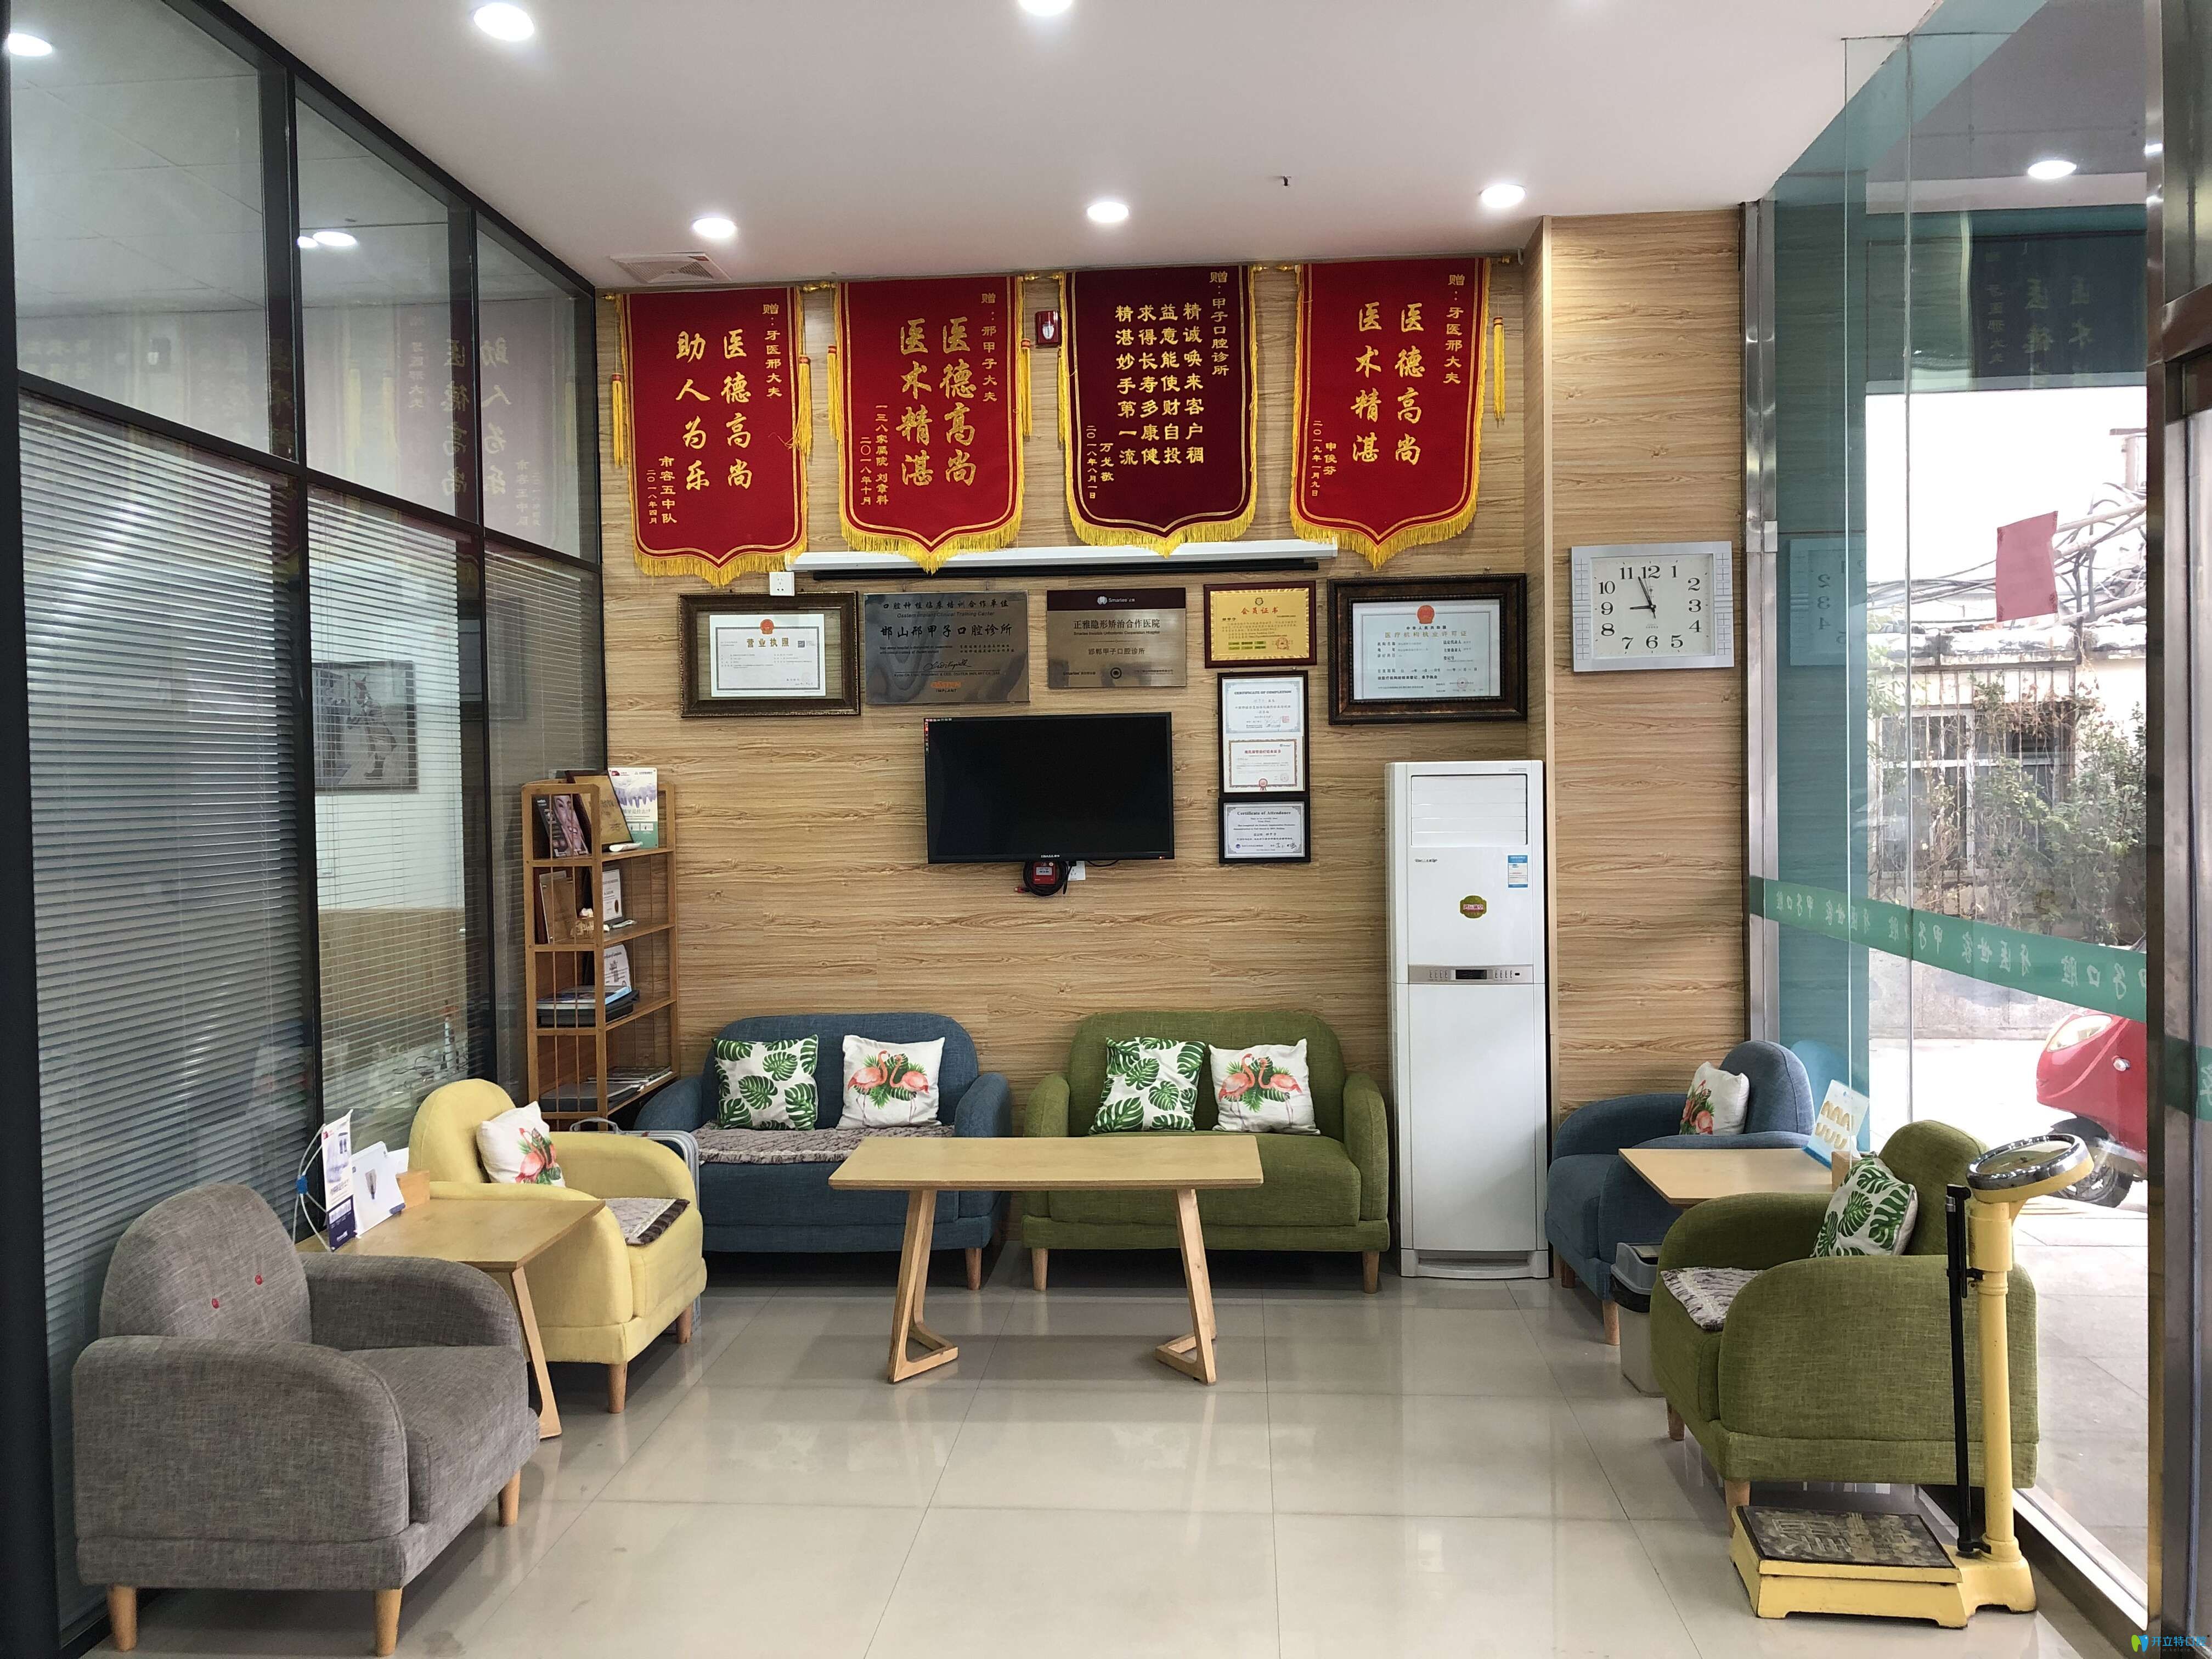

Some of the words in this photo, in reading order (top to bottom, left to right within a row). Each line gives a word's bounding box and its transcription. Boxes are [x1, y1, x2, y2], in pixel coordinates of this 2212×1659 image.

[1115, 304, 1138, 466] 精湛妙手第一流
[1137, 304, 1160, 465] 求得长寿多康健
[1159, 304, 1182, 465] 益意能使财自投
[1183, 302, 1205, 464] 精诚唤来客户稠
[1350, 301, 1383, 462] 医术精湛
[1395, 302, 1426, 466] 医德高尚
[895, 318, 933, 486] 医术精湛
[939, 316, 977, 486] 医德高尚
[675, 331, 710, 491] 助人为乐
[720, 329, 753, 490] 医德高尚
[659, 456, 677, 524] 市容五中队
[1620, 567, 1633, 579] 11
[1641, 565, 1661, 579] 12
[1671, 565, 1677, 578] 1
[1599, 580, 1616, 594] 10
[1688, 578, 1700, 591] 2
[1241, 606, 1278, 614] 会员证书
[1601, 602, 1613, 615] 9
[1689, 599, 1701, 612] 3
[1073, 619, 1160, 629] 正雅隐形矫治合作医院
[1601, 623, 1615, 636] 8
[1689, 620, 1702, 633] 4
[880, 623, 1013, 640] 邯山邢甲子口腔诊所
[747, 637, 789, 647] 营业执照
[1622, 637, 1634, 650] 7
[1646, 635, 1658, 648] 6
[1671, 635, 1683, 648] 5
